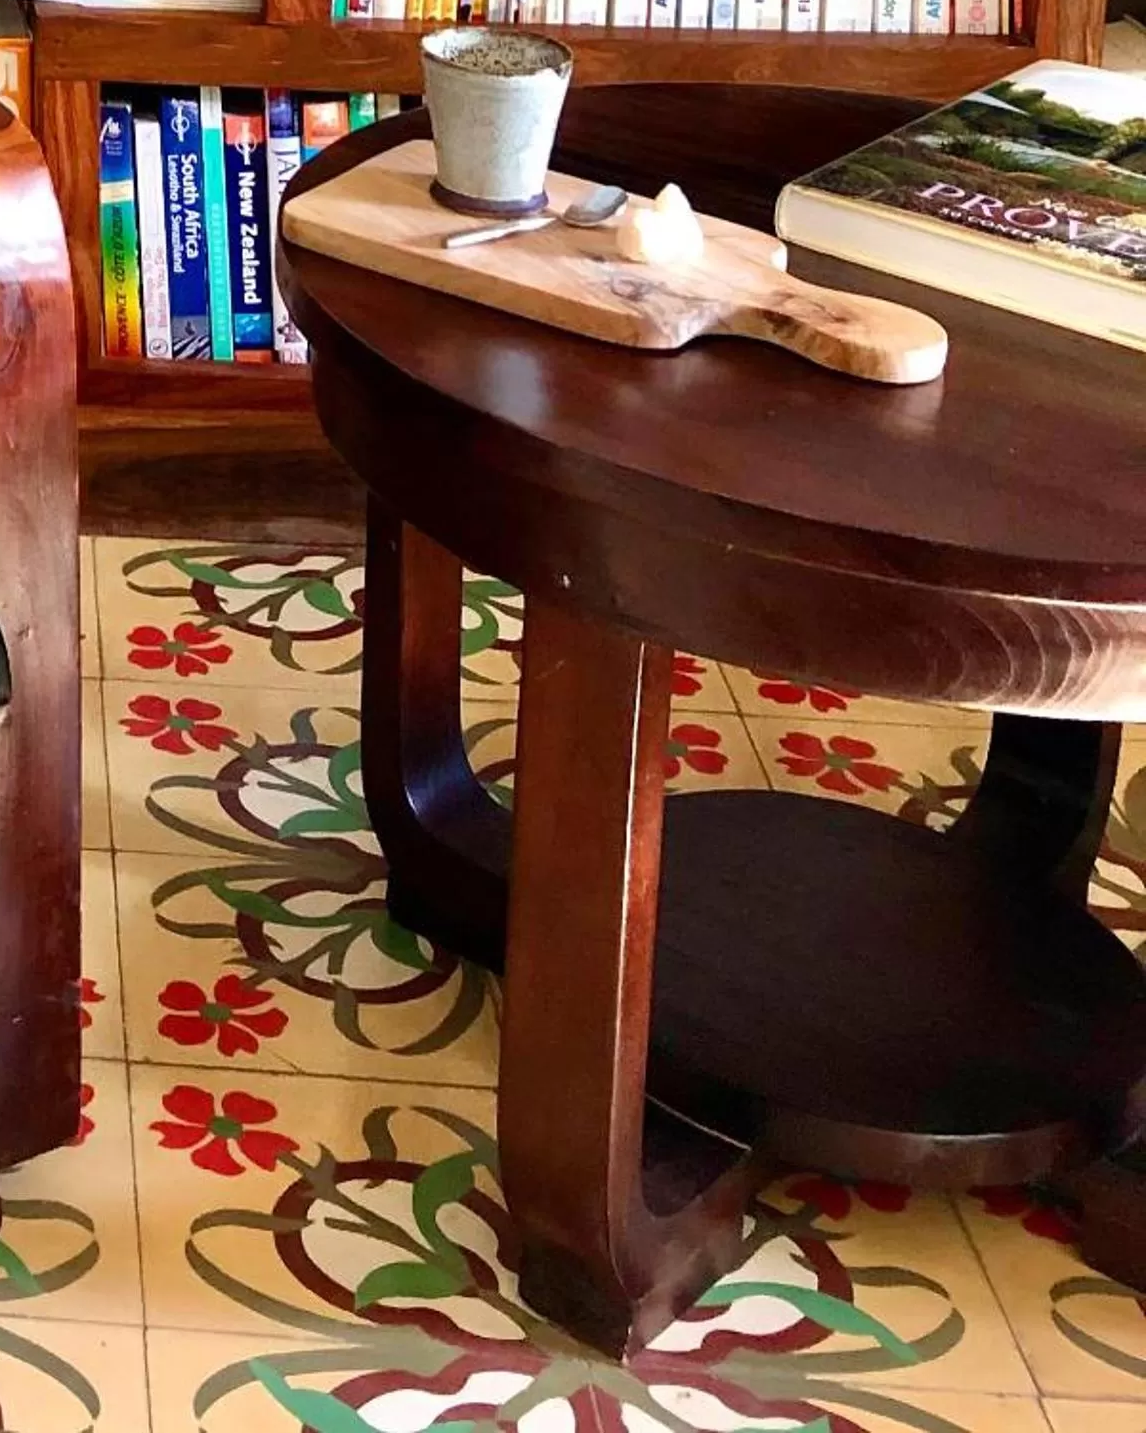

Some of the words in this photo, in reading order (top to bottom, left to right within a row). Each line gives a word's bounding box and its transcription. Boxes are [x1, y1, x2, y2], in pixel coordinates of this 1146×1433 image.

[167, 154, 181, 202] Lesotho
[181, 153, 198, 205] South
[237, 171, 256, 216] New
[170, 203, 181, 213] &
[184, 208, 202, 259] Africa
[169, 214, 185, 274] Swaziland
[239, 222, 261, 305] Zealand
